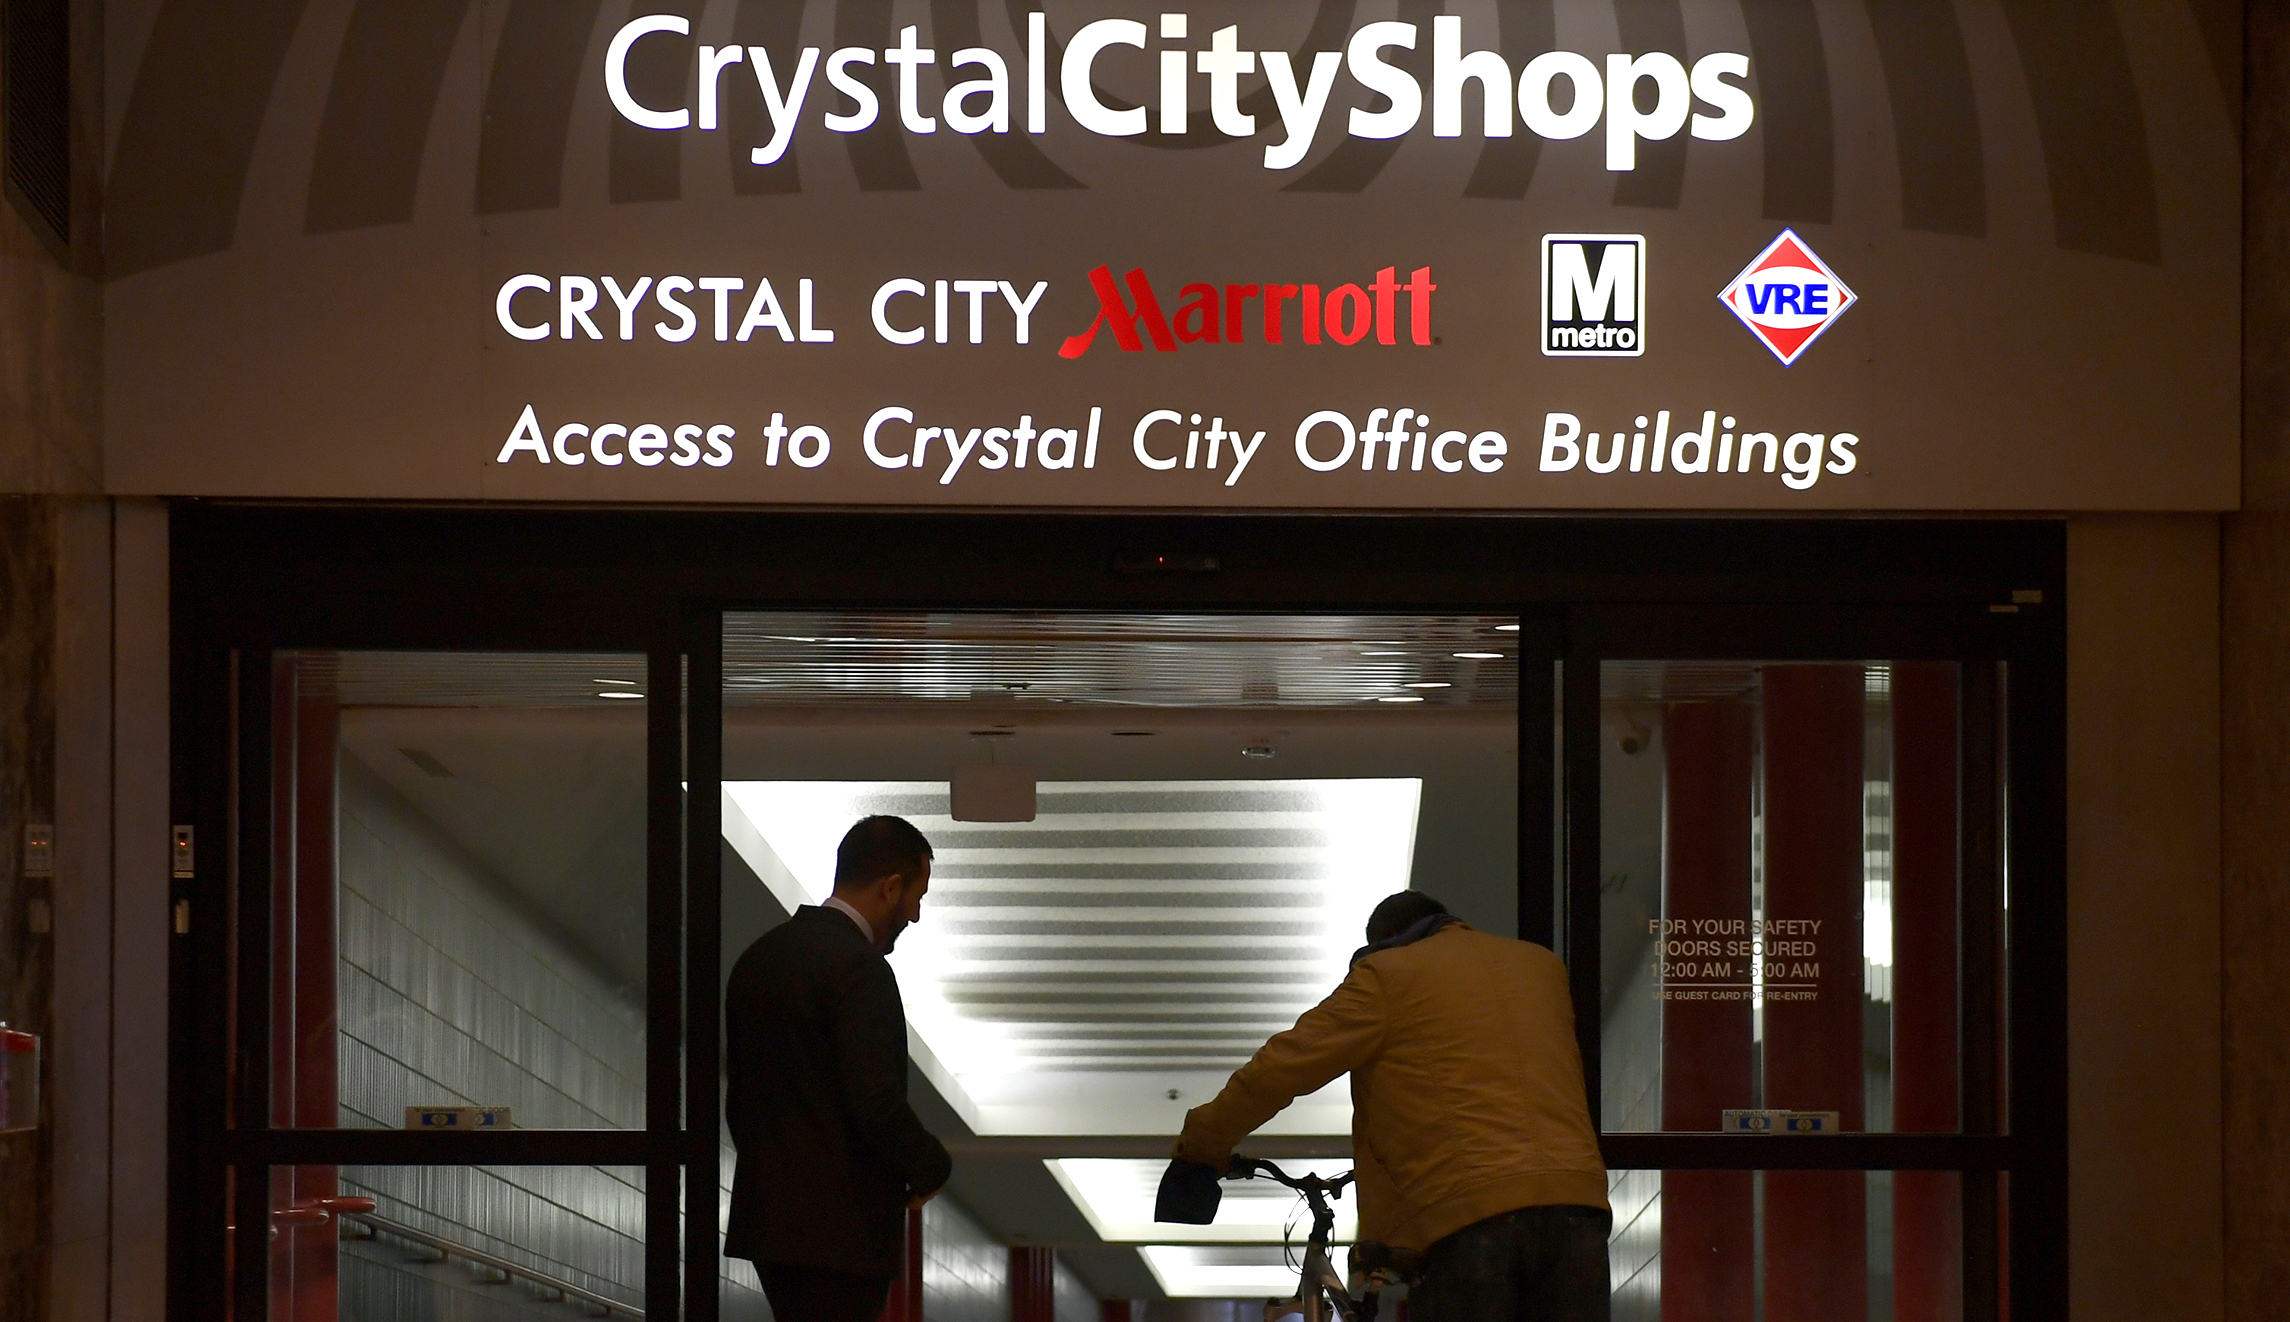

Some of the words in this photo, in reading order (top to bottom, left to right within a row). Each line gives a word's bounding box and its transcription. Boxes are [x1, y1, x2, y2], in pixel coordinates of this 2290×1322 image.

[604, 12, 1754, 171] CrystalCityShops
[1552, 243, 1635, 321] M
[496, 274, 834, 343] CRYSTAL
[871, 278, 1048, 345] CITY
[1058, 265, 1437, 359] Marriott
[1745, 284, 1828, 315] VRE
[1552, 324, 1635, 348] metro
[496, 404, 736, 467] Access
[763, 412, 831, 468] to
[863, 406, 1102, 485] Crystal
[1133, 409, 1267, 487] City
[1294, 407, 1508, 473] Office
[1539, 410, 1859, 490] Buildings
[1648, 919, 1687, 935] FOR
[1692, 919, 1745, 935] YOUR
[1751, 920, 1822, 935] SAFETY
[1654, 940, 1721, 956] DOORS
[1726, 941, 1816, 956] SECURED
[1650, 962, 1697, 978] 12:00
[1701, 962, 1731, 978] AM
[1749, 962, 1785, 978] 5:00
[1790, 962, 1819, 978] AM
[1652, 991, 1673, 1000] USE
[1674, 991, 1709, 1000] GUEST
[1711, 991, 1741, 1000] CARD
[1743, 991, 1763, 1001] FOR
[1766, 991, 1818, 1001] RE-ENTRY
